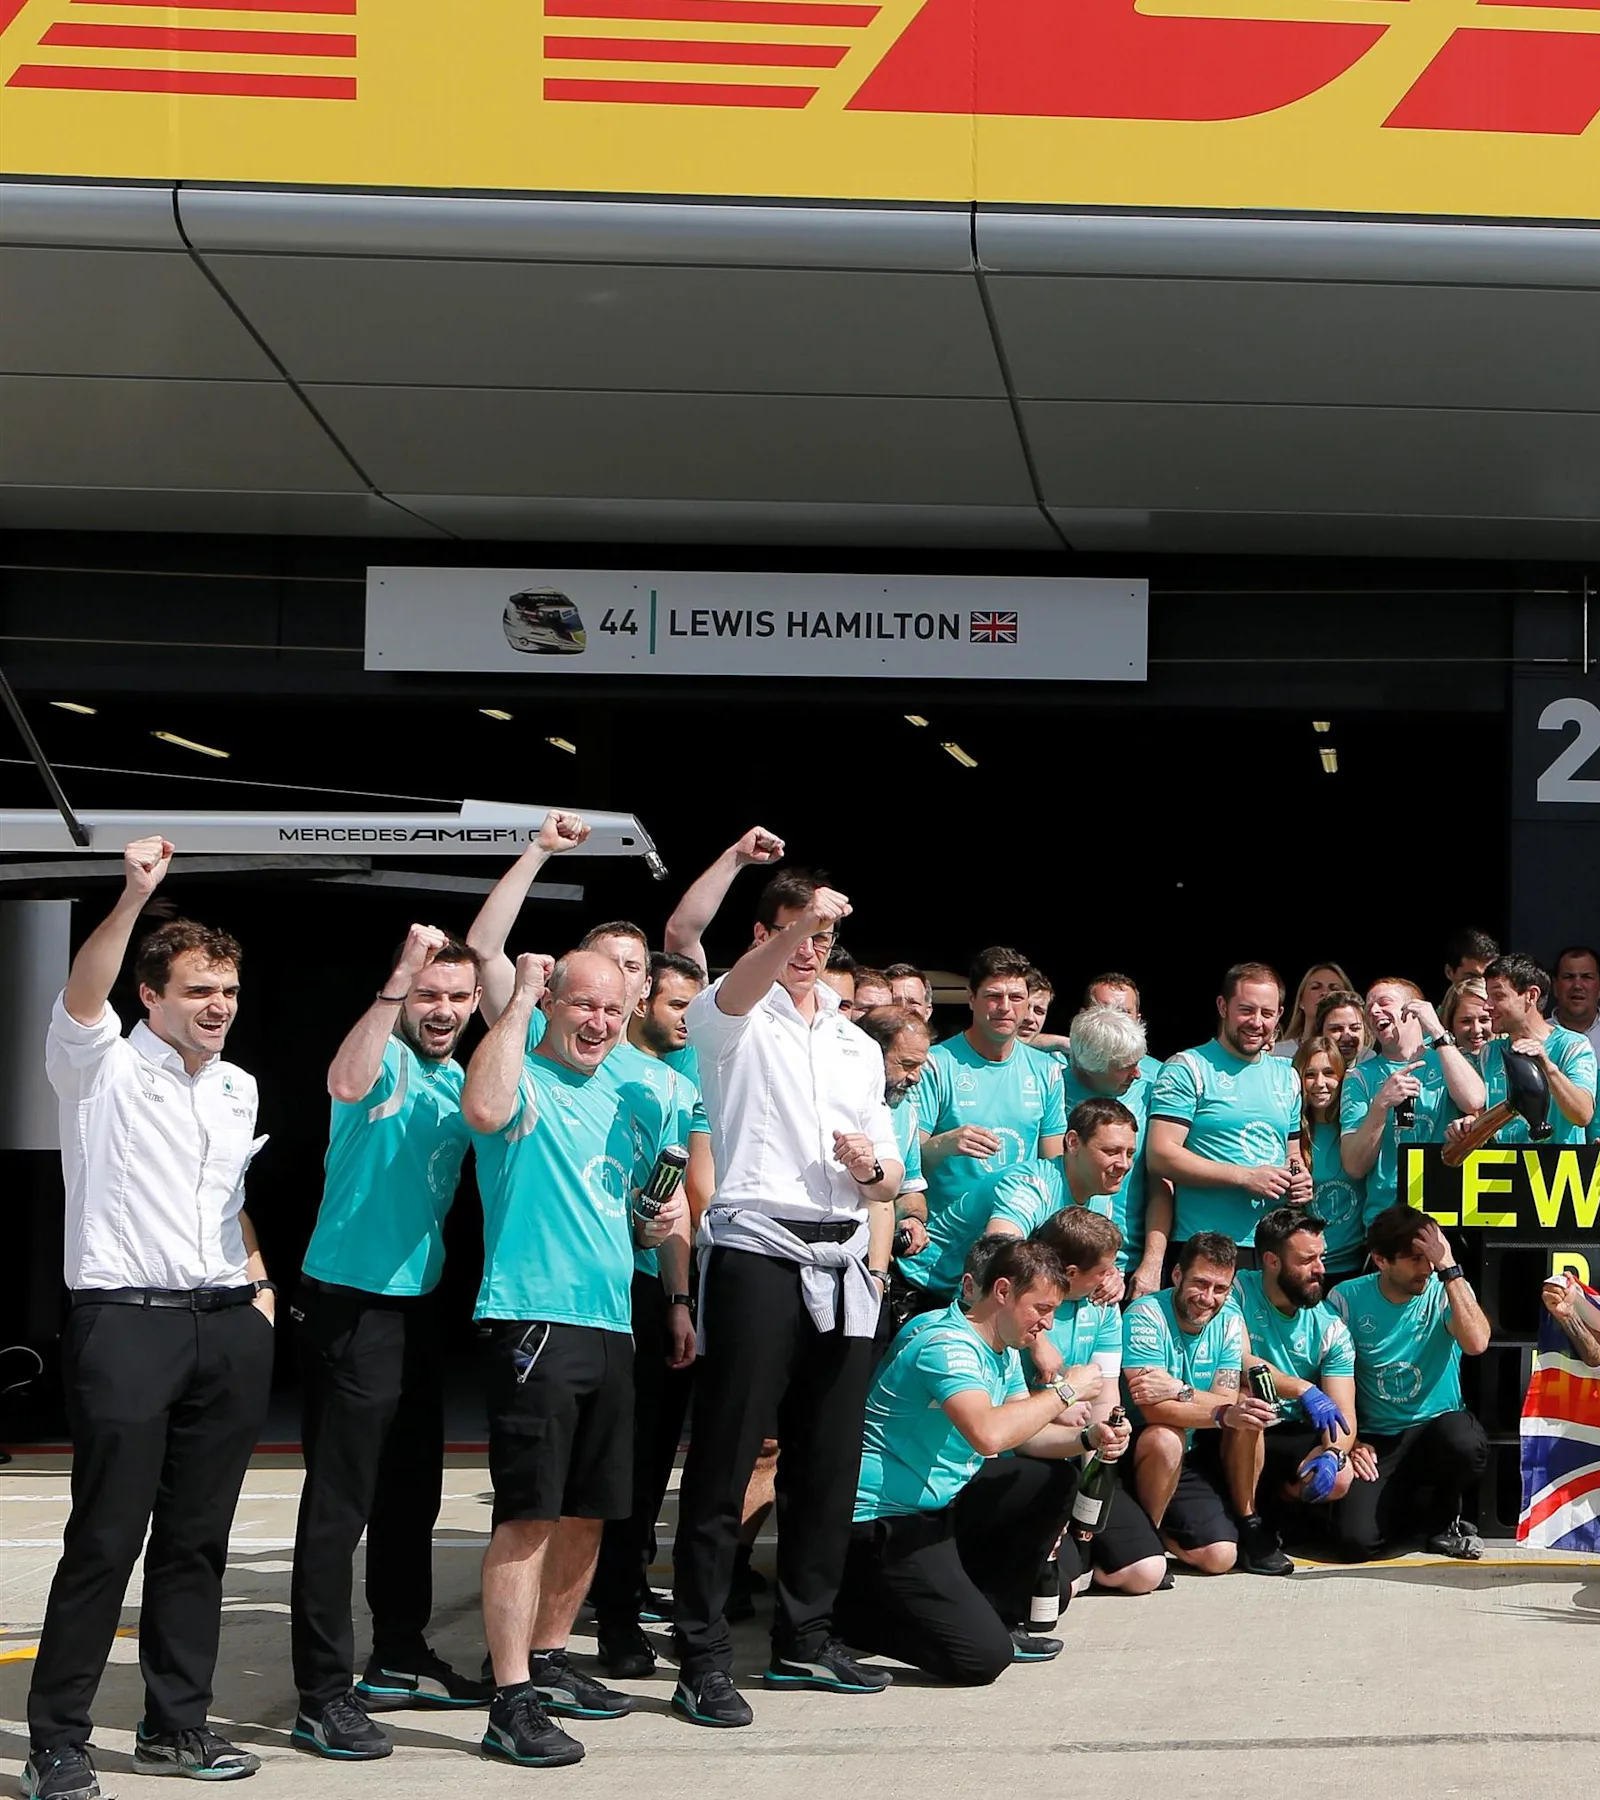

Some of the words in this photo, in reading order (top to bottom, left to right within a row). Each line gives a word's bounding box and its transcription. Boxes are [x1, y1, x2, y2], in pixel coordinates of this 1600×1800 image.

[599, 608, 638, 636] 44
[669, 609, 776, 637] LEWIS
[786, 612, 961, 640] HAMILTON
